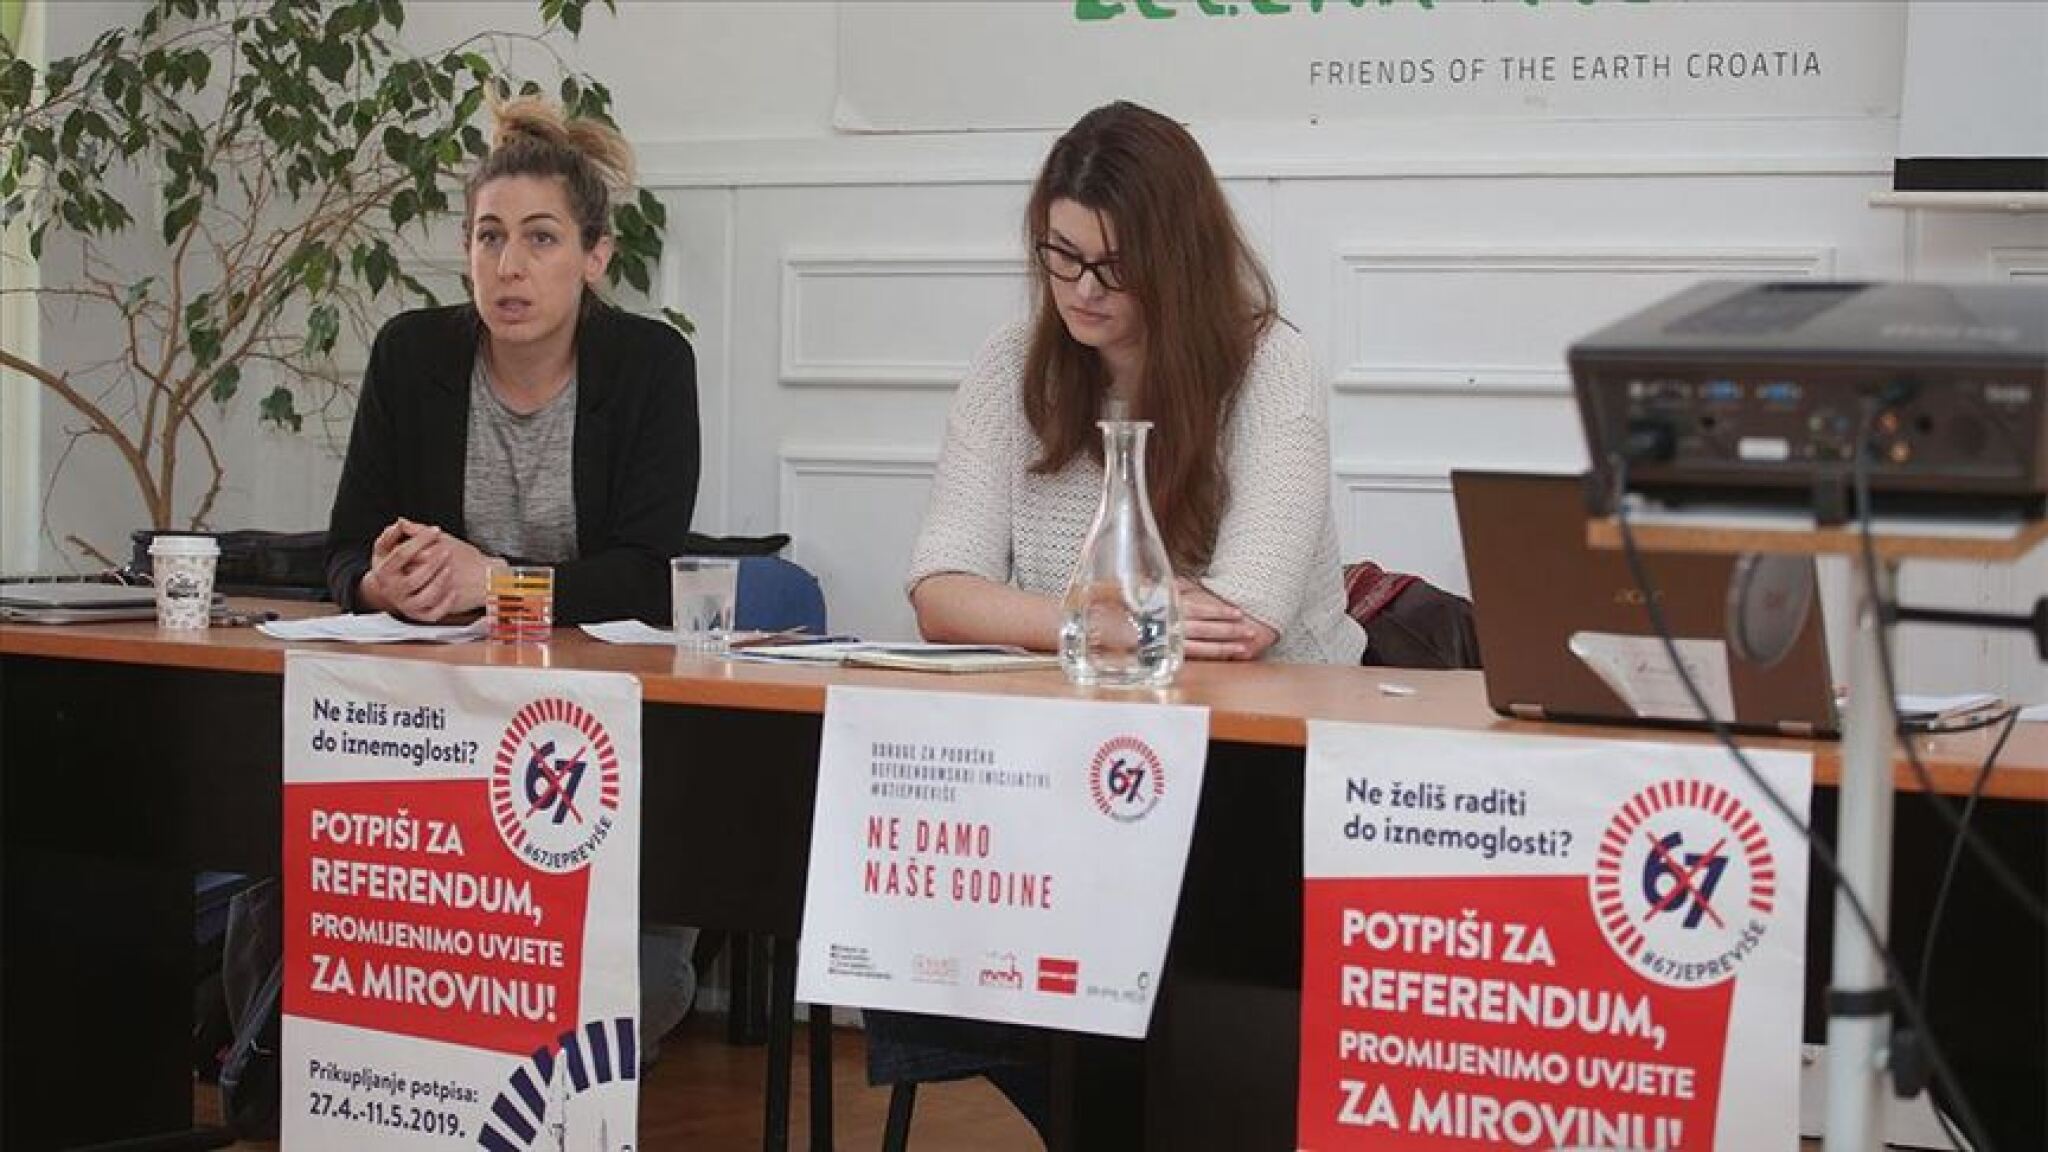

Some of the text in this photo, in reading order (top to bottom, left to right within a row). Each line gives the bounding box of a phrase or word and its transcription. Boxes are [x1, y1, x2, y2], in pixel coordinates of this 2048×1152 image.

[1309, 51, 1822, 85] FRIENDS OF THE EARTH CROATIA
[313, 698, 446, 731] Ne želiš raditi
[312, 728, 479, 767] do iznemoglosti?
[1345, 778, 1526, 817] Ne želiš raditi
[311, 806, 464, 857] POTPIŠI ZA
[866, 815, 990, 859] NE DAMO
[1344, 814, 1573, 859] do iznemoglosti?
[311, 856, 543, 928] REFERENDUM,
[864, 857, 1054, 909] NAŠE GODINE
[310, 912, 564, 968] PROMIJENIMO UVJETE
[1342, 907, 1556, 966] POTPIŠI ZA
[1642, 918, 1767, 981] #67JEPREVIŠE
[310, 954, 557, 1023] ZA MIROVINU!
[1341, 966, 1667, 1050] REFERENDUM,
[309, 1059, 479, 1103] Prikupljanje potpisa:
[1339, 1030, 1696, 1099] PROMIJENIMO UVJETE
[309, 1092, 466, 1139] 27.4.-11.5.2019.
[1336, 1079, 1400, 1130] ZA
